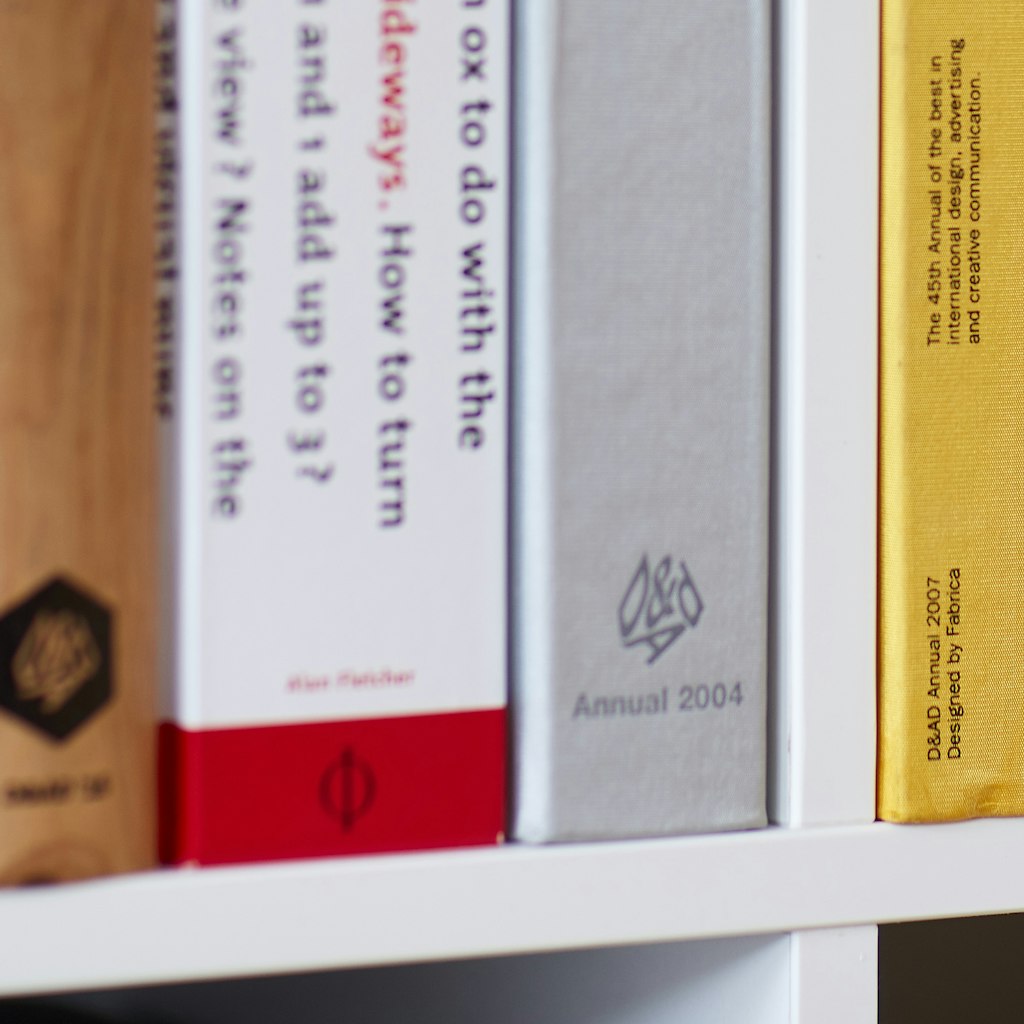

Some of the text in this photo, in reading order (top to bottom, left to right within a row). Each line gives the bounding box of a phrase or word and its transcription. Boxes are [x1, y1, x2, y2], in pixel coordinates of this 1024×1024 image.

[297, 24, 335, 118] and
[460, 26, 487, 80] ox
[459, 100, 493, 148] to
[296, 170, 335, 263] add
[458, 165, 496, 225] do
[926, 55, 943, 346] The 45th Annual of the best in
[946, 37, 965, 345] international design, advertising
[966, 71, 982, 345] and creative communication.
[212, 198, 249, 341] Notes
[285, 281, 326, 347] up
[378, 224, 412, 335] How
[458, 242, 496, 354] with
[211, 358, 242, 420] on
[295, 363, 330, 414] to
[378, 352, 412, 402] to
[458, 367, 495, 451] the
[211, 438, 252, 519] the
[377, 418, 412, 528] turn
[573, 681, 744, 719] Annual 2004
[927, 576, 941, 762] D&AD Annual 2007
[946, 567, 964, 760] Designed by Fabrica
